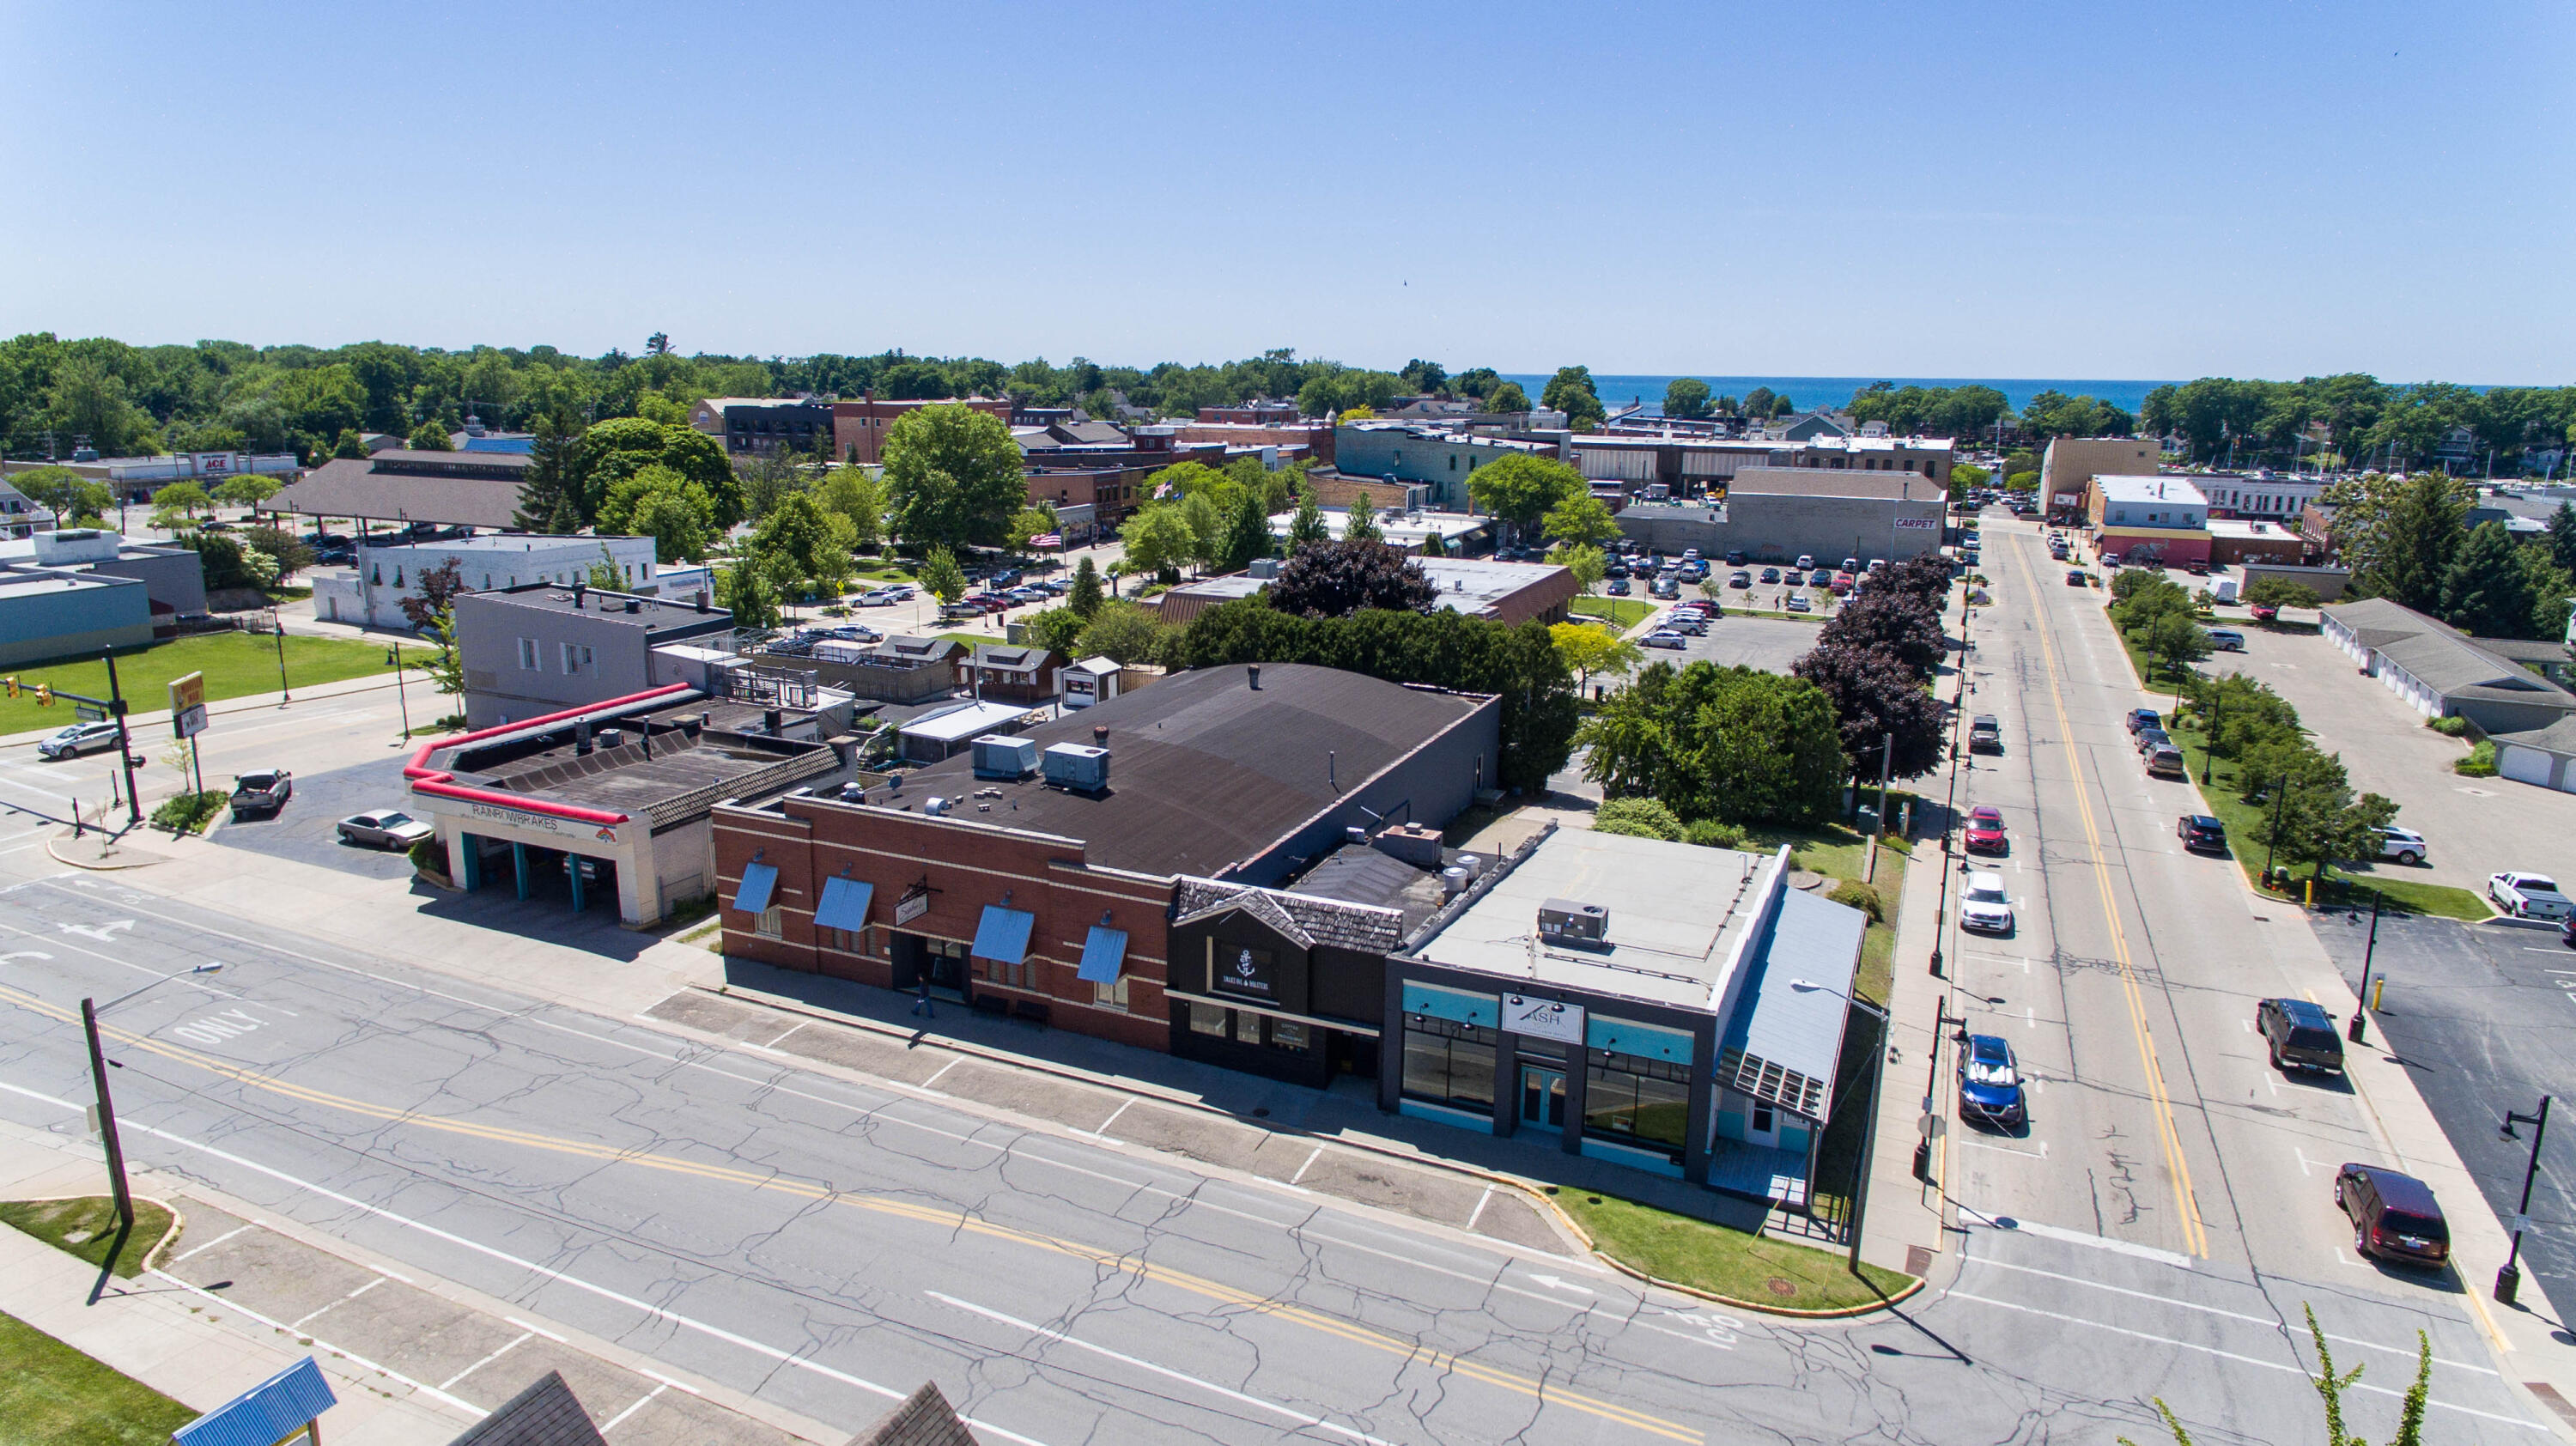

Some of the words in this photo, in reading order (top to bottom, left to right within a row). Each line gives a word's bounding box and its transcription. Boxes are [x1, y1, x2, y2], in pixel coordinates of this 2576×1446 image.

[205, 459, 227, 468] ACE
[1895, 519, 1935, 528] CARPET
[1522, 1007, 1559, 1025] ASH
[173, 1008, 269, 1044] ONLY
